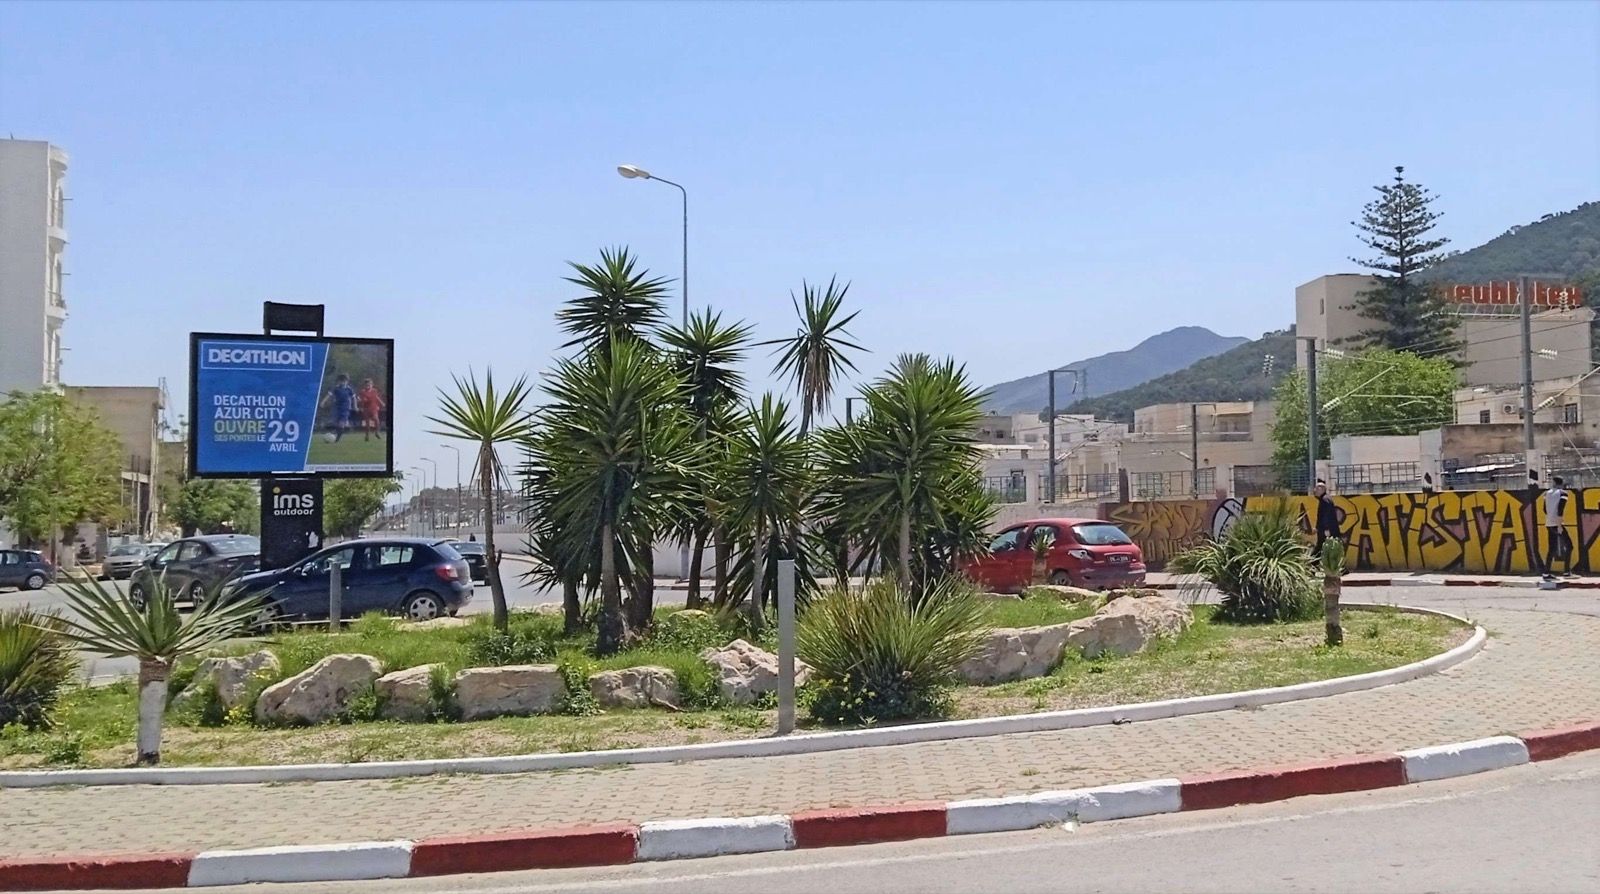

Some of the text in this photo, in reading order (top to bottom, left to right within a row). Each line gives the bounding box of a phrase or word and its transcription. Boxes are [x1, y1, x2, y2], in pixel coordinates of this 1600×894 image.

[1443, 280, 1582, 306] eubltex
[208, 348, 305, 365] DECATHLON
[213, 394, 286, 407] DECATHLON
[214, 406, 286, 420] AZUR CITY
[214, 420, 266, 434] OUVRE
[268, 420, 300, 443] 29
[214, 434, 228, 442] SES
[257, 434, 266, 442] LE
[269, 443, 298, 452] AVRIL
[272, 486, 314, 509] ims
[273, 508, 314, 516] outdoor
